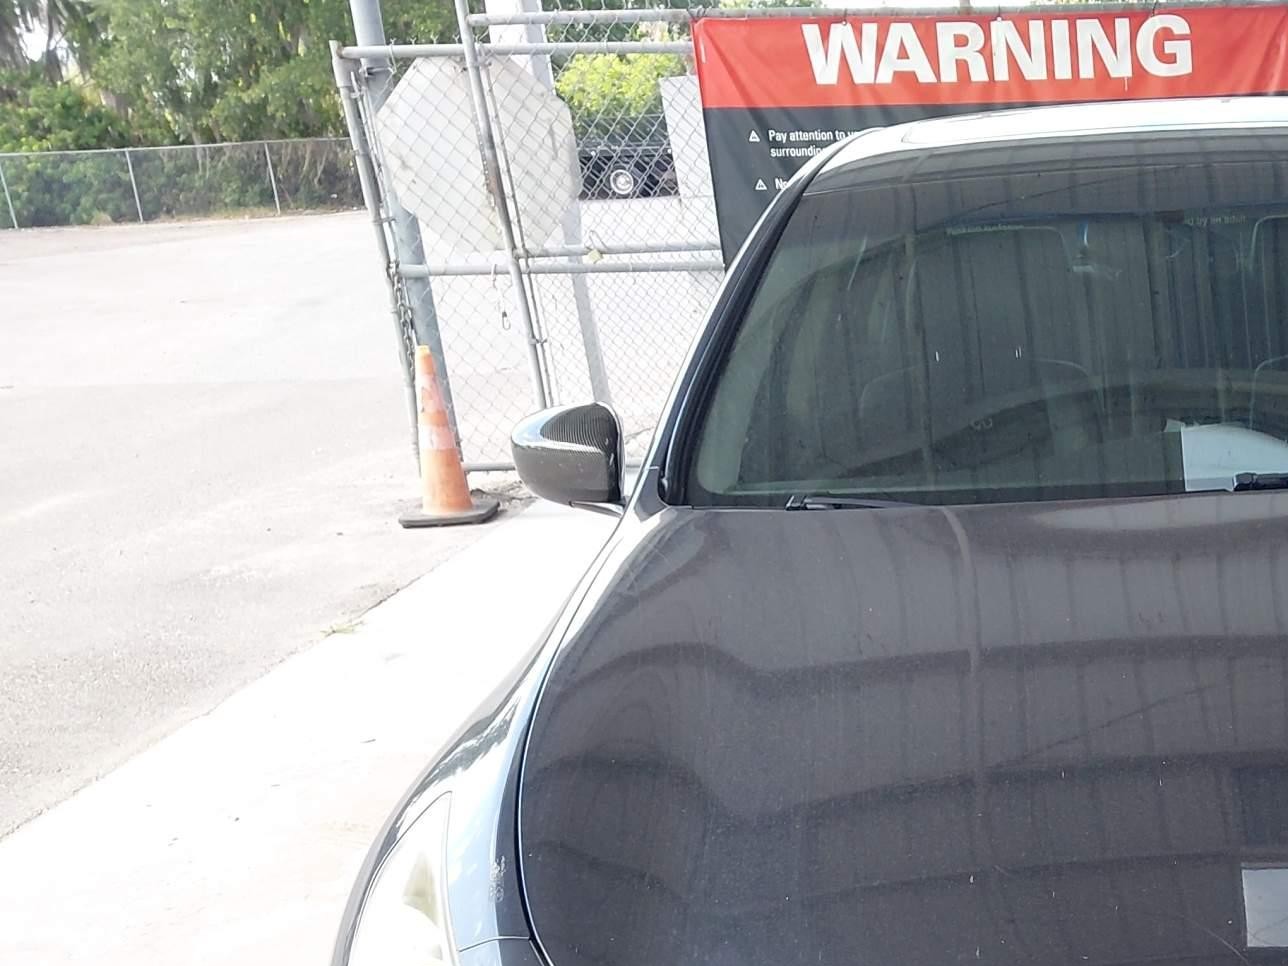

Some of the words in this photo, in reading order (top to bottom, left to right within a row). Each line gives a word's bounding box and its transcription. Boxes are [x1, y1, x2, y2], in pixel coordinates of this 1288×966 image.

[801, 15, 1194, 85] WARNING
[768, 129, 787, 144] Pay
[789, 129, 833, 141] attention
[834, 130, 846, 141] to
